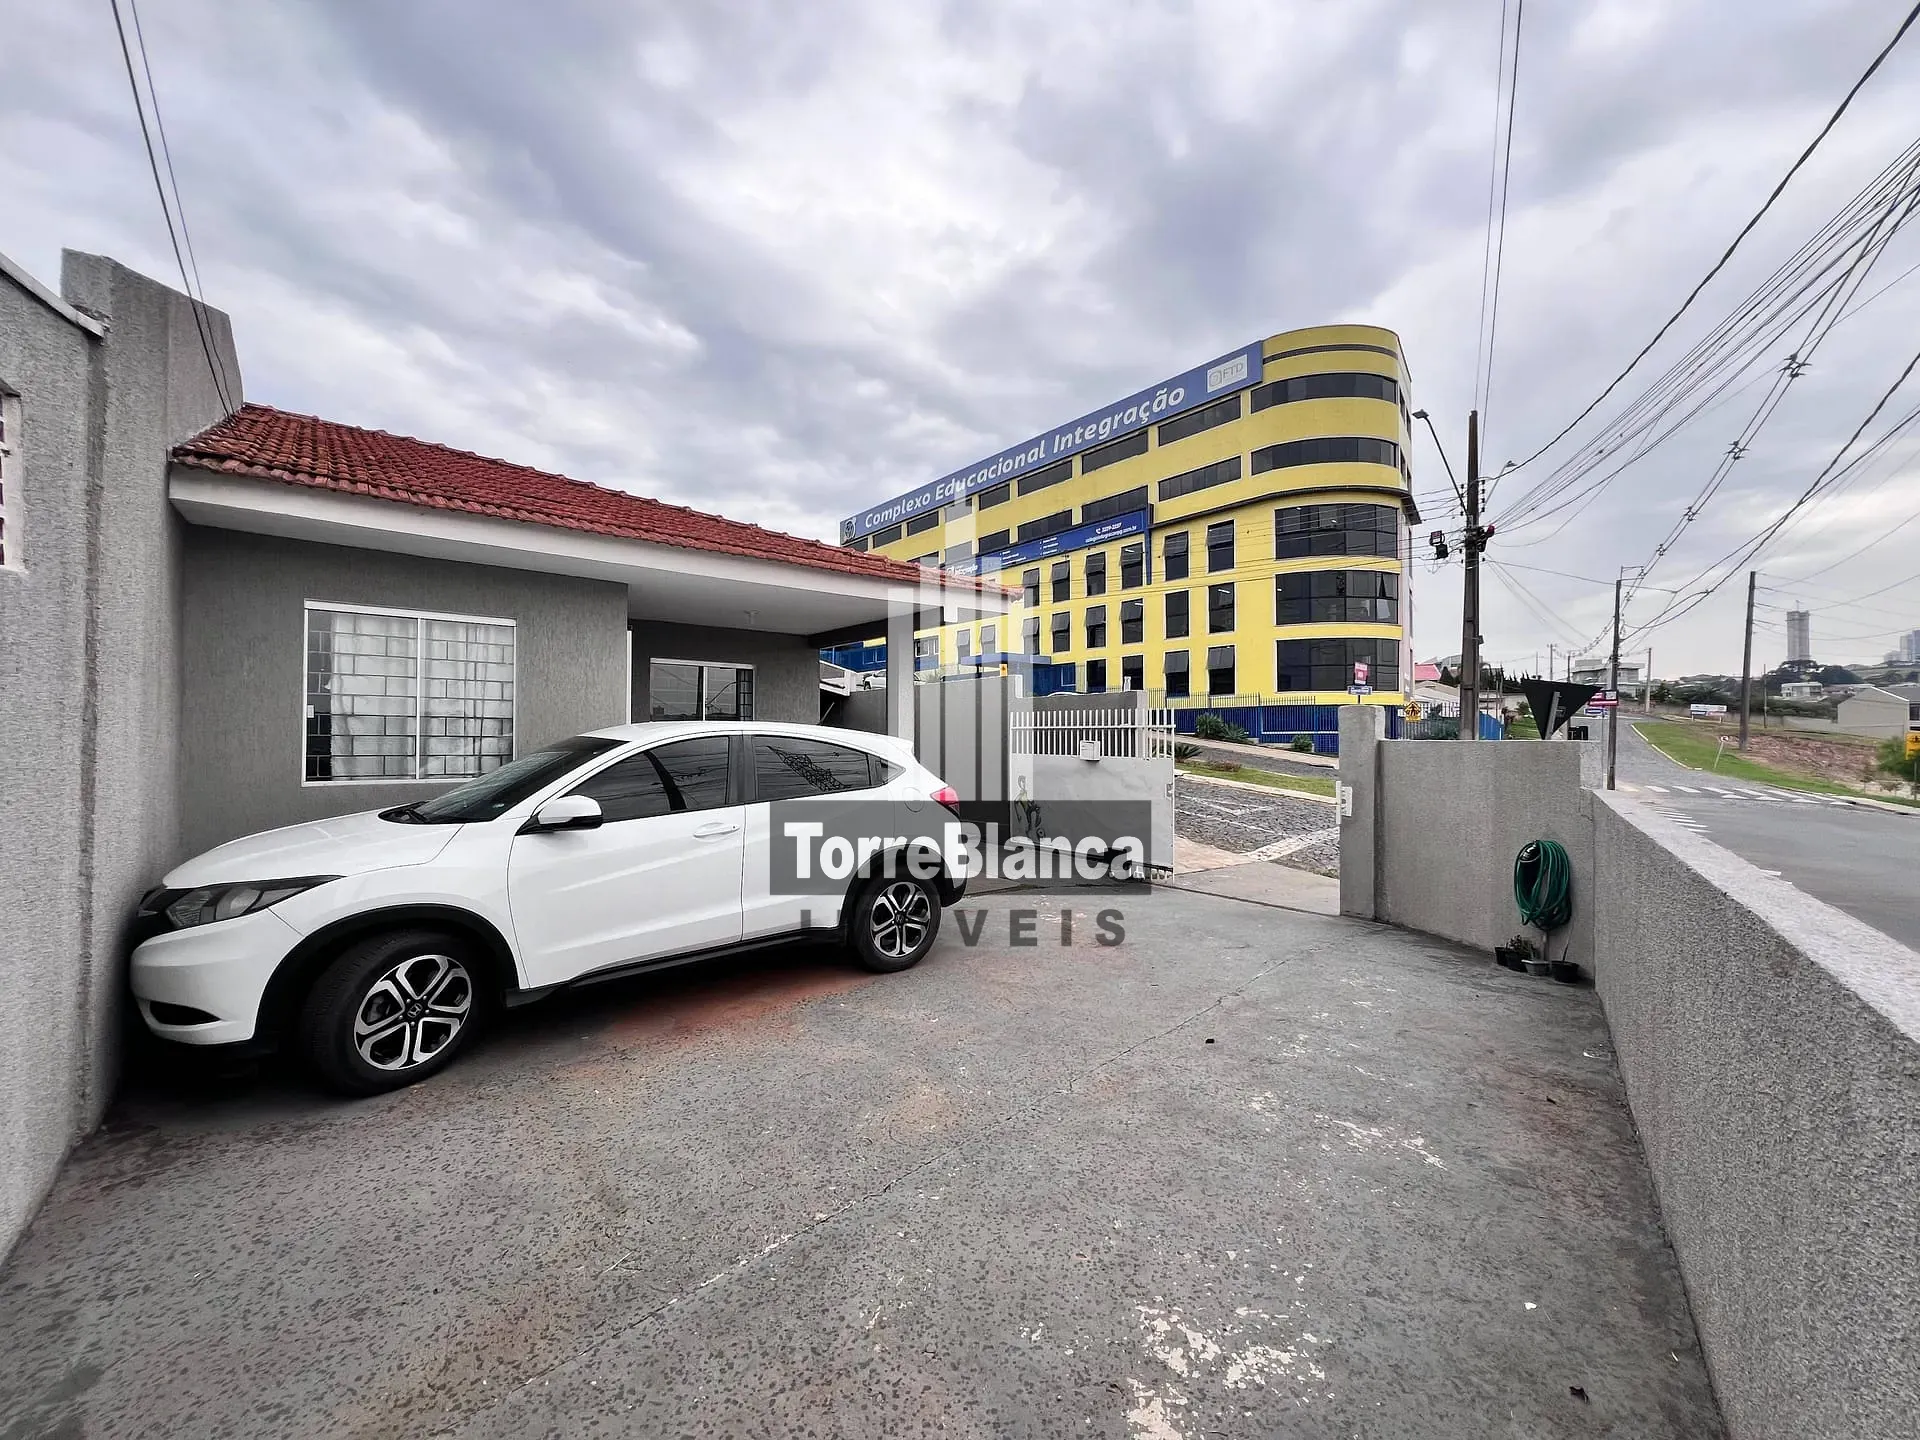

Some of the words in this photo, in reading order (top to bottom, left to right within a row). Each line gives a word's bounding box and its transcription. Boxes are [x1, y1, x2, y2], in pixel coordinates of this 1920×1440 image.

[1223, 362, 1244, 379] FTD
[865, 493, 931, 528] Complexo
[935, 439, 1046, 501] Educacional
[1053, 387, 1185, 453] Integração
